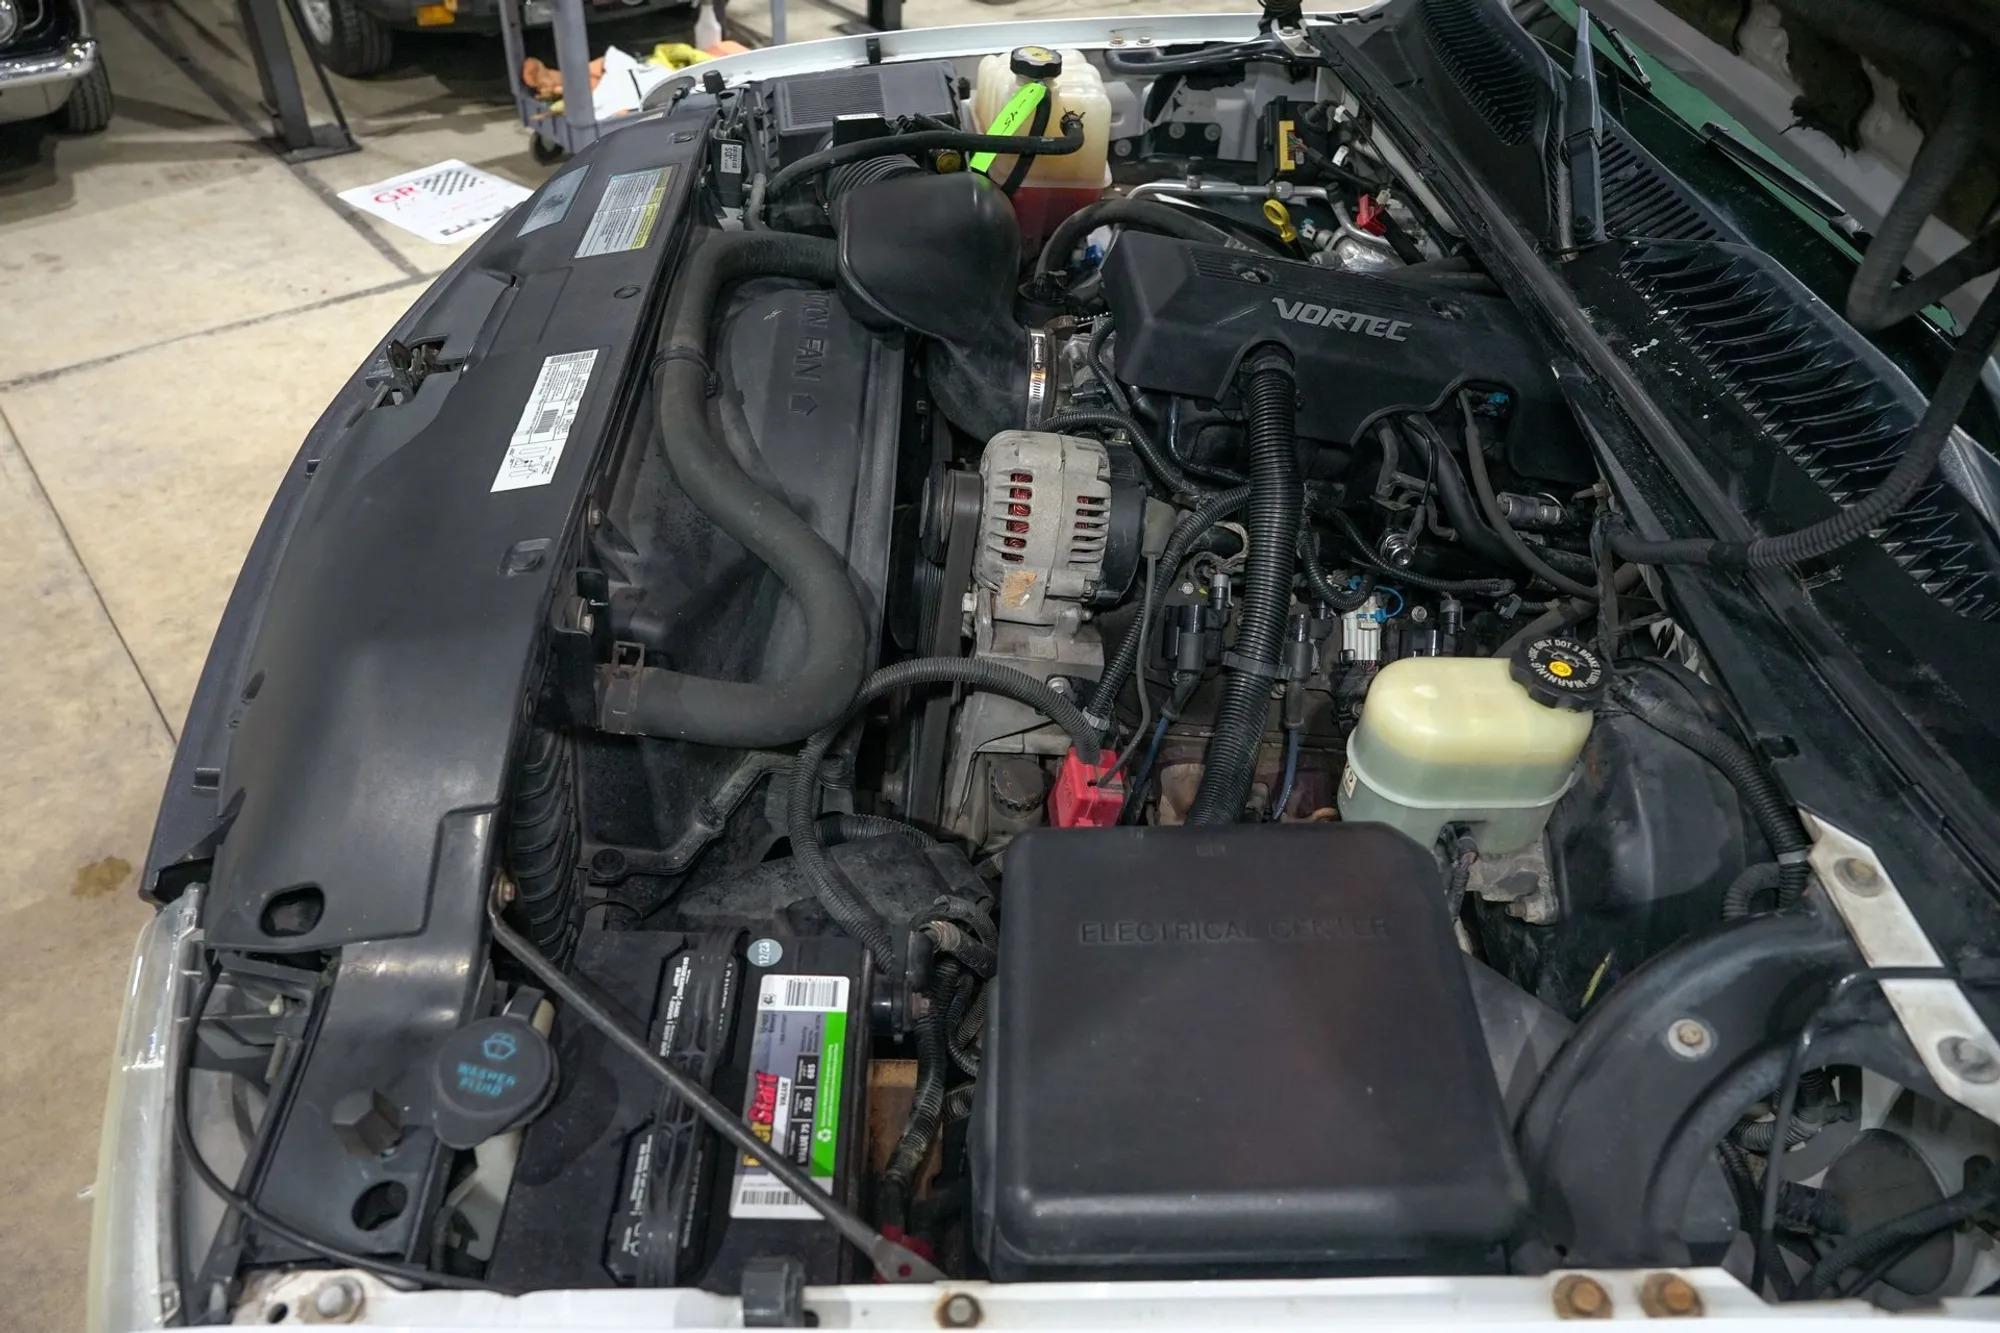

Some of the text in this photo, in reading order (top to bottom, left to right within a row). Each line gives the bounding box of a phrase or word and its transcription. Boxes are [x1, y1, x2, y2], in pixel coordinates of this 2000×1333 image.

[1271, 297, 1413, 342] VORTEC
[1554, 639, 1573, 648] DOT
[1579, 650, 1601, 668] BRAKE
[1531, 663, 1587, 688] WARNING
[1079, 919, 1257, 945] ELECTRICAL
[758, 942, 770, 965] 12/23
[457, 1063, 516, 1087] WASHER
[459, 1077, 503, 1096] FLUID
[779, 1082, 789, 1106] VALUE
[797, 1123, 811, 1164] VALUE 75
